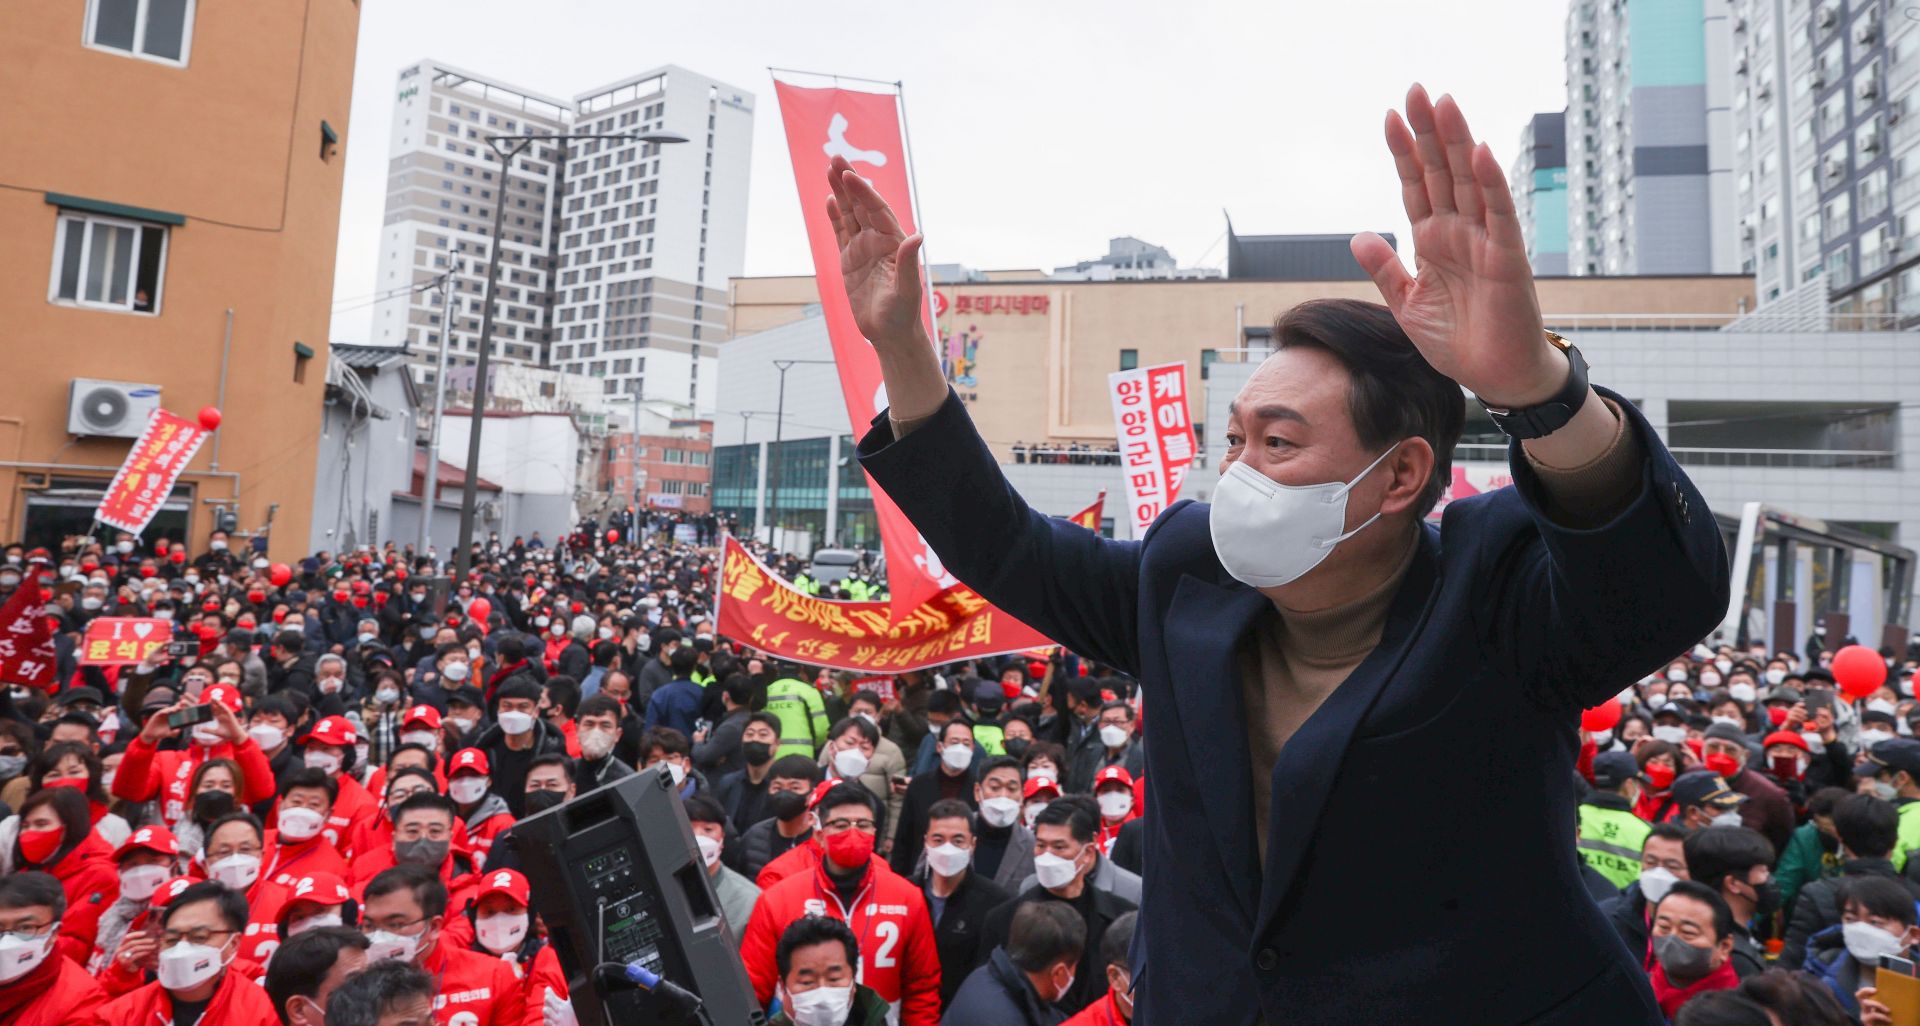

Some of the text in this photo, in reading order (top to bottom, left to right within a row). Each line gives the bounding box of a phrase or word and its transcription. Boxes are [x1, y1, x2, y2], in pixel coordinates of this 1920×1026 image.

[955, 295, 1050, 315] 롯데시네마
[492, 871, 512, 888] 2
[874, 921, 899, 968] 2
